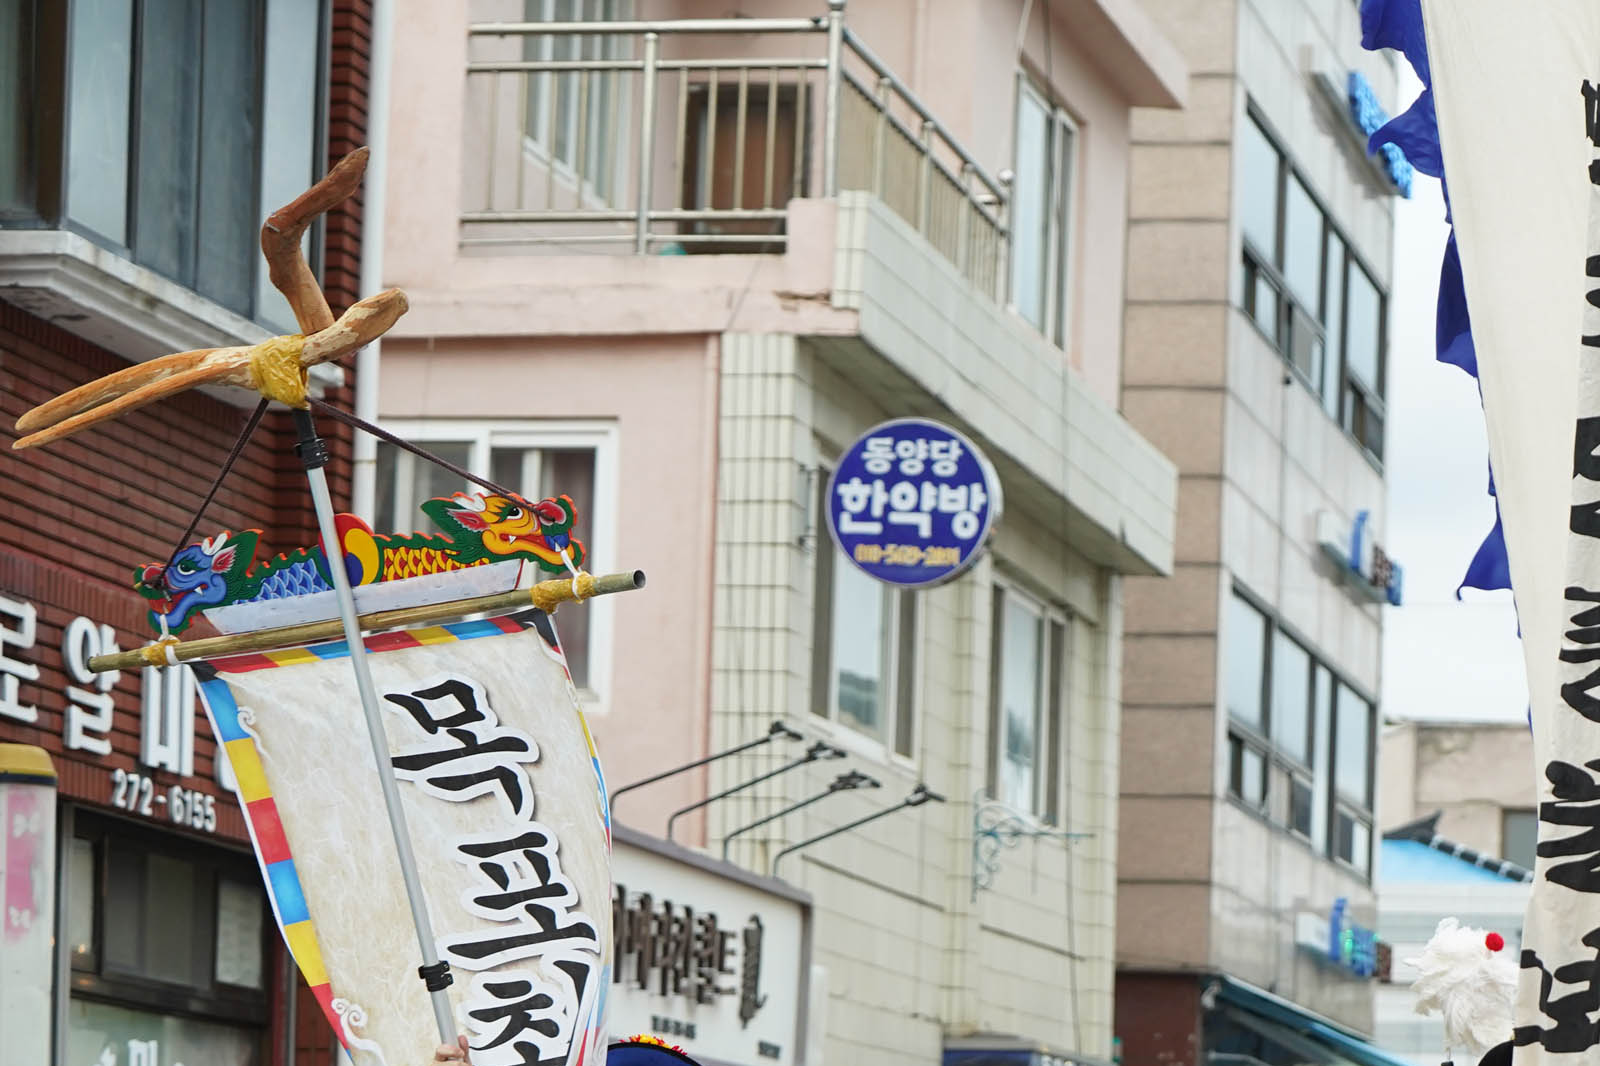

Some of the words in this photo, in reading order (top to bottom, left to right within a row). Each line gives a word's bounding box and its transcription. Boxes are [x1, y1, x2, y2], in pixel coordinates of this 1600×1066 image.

[860, 436, 964, 478] 동양당
[836, 475, 988, 541] 한약방
[112, 767, 217, 833] 272-6155
